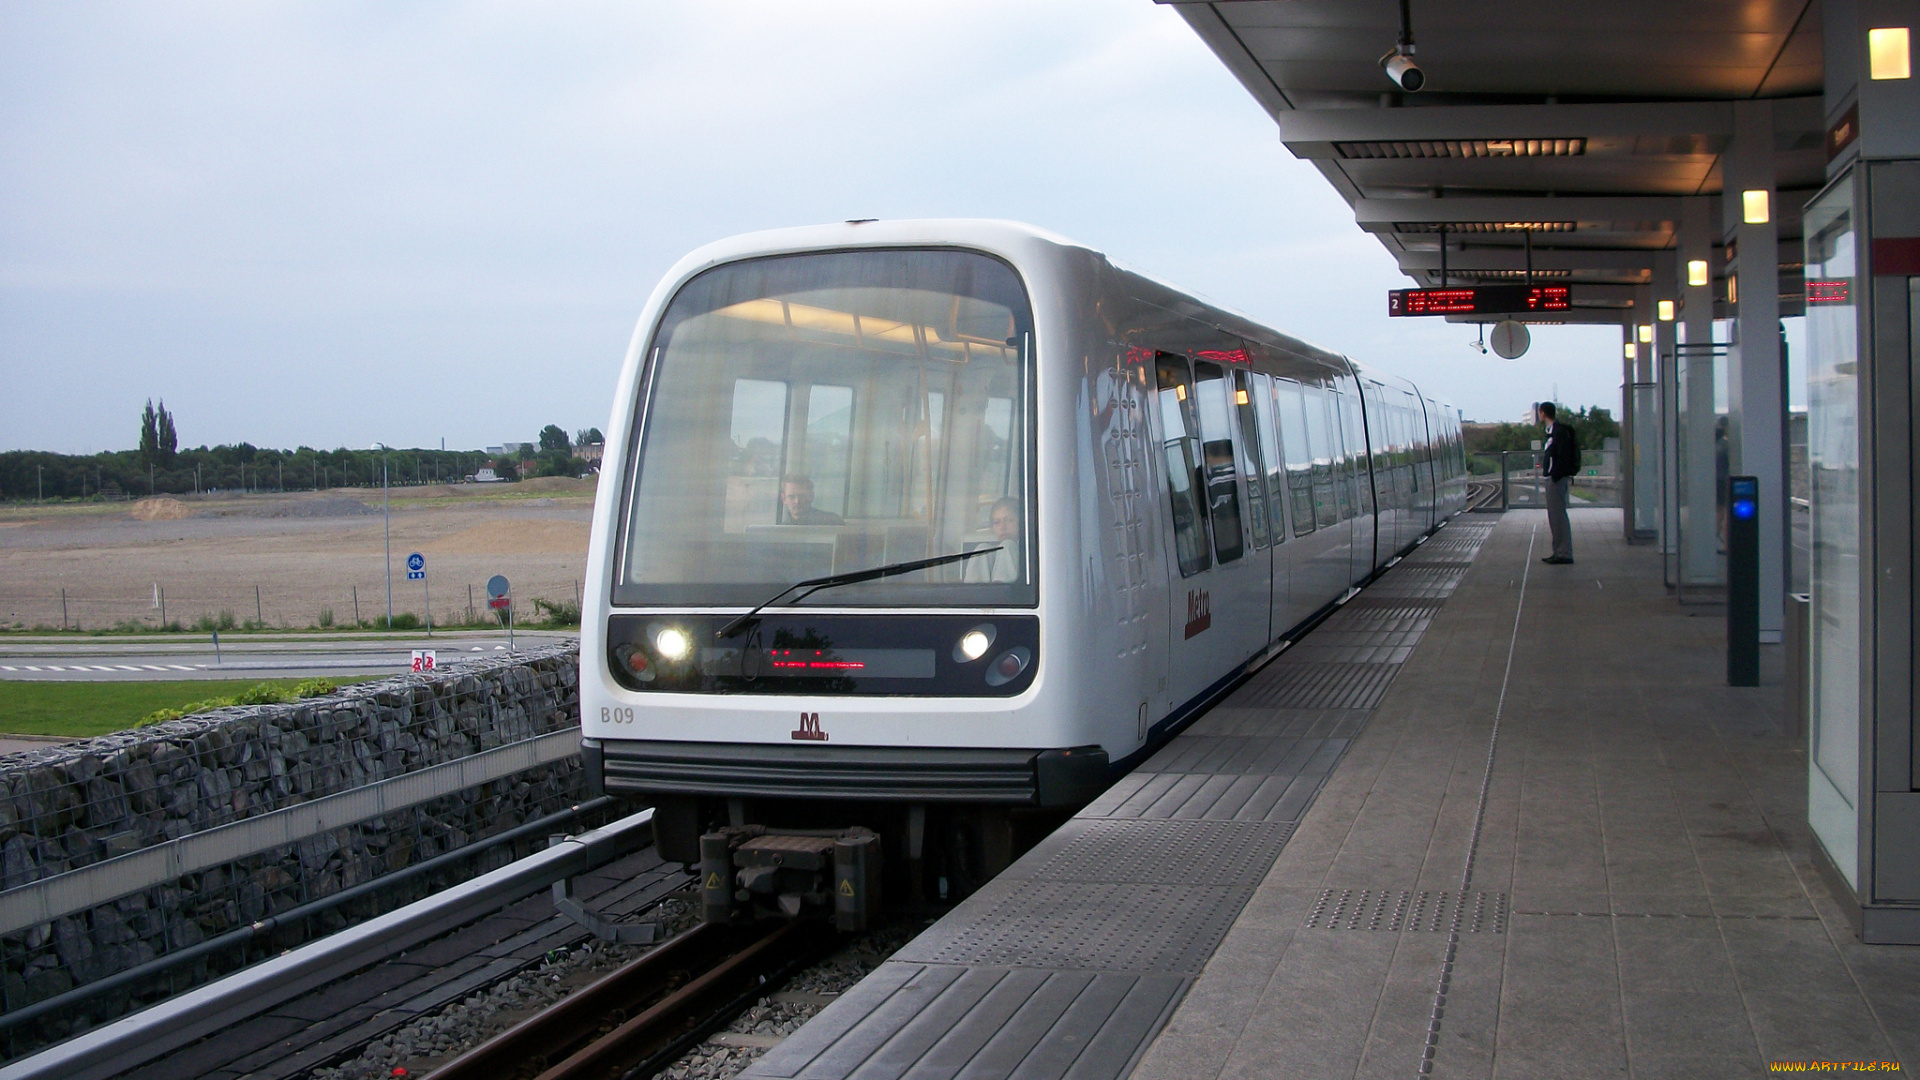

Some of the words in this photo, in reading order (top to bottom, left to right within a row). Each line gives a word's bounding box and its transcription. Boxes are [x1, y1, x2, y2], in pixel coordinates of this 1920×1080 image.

[1391, 299, 1399, 310] 2
[1187, 587, 1210, 624] Metro
[601, 707, 611, 723] B
[614, 707, 634, 724] 09
